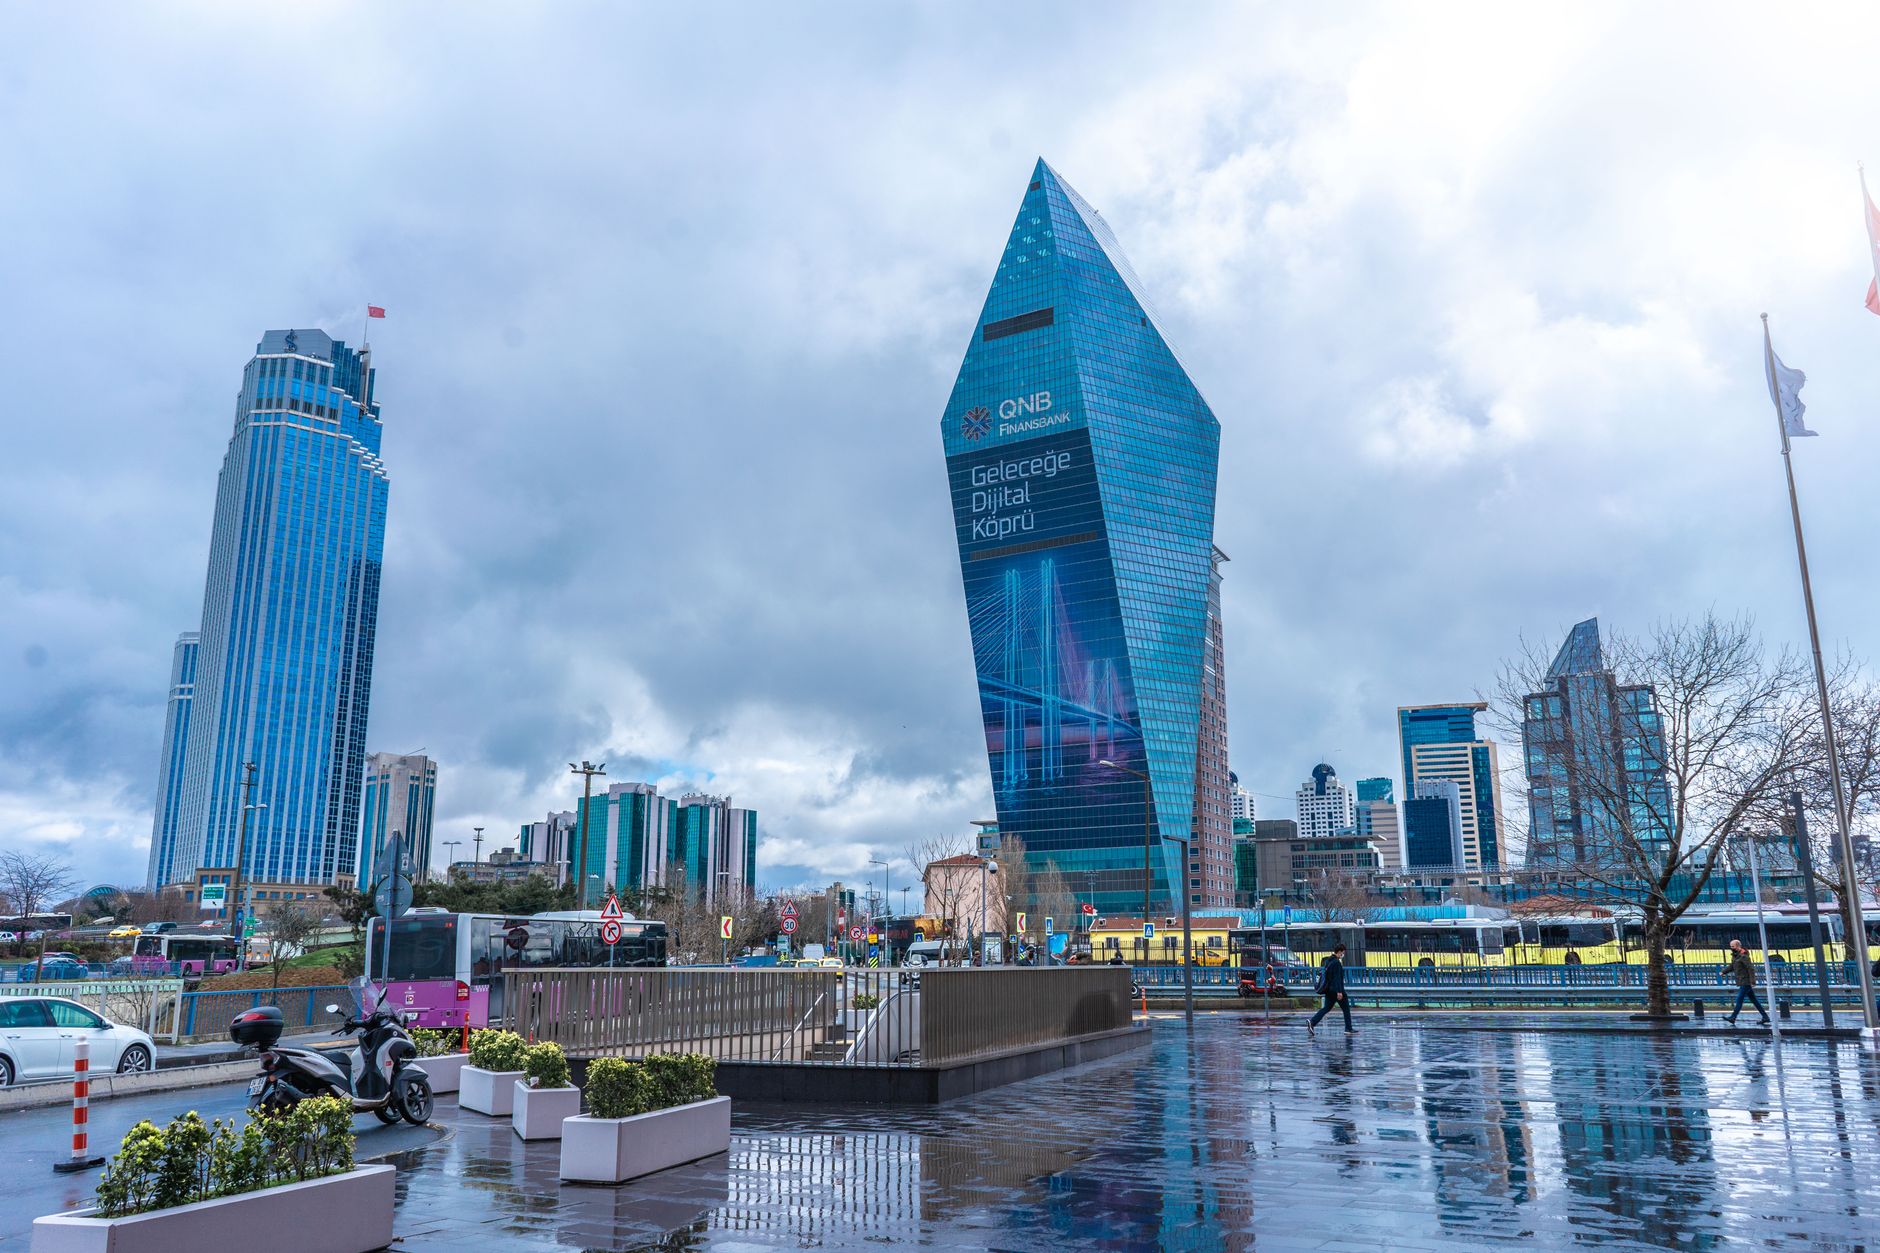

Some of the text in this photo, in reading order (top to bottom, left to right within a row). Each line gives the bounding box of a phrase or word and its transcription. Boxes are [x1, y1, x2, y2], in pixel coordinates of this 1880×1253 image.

[999, 391, 1052, 419] QNB
[1000, 412, 1070, 436] FINANSBANK
[972, 450, 1071, 487] Geleceğe
[972, 482, 1030, 514] Dijital
[972, 509, 1034, 540] Köprü
[784, 921, 795, 930] 30
